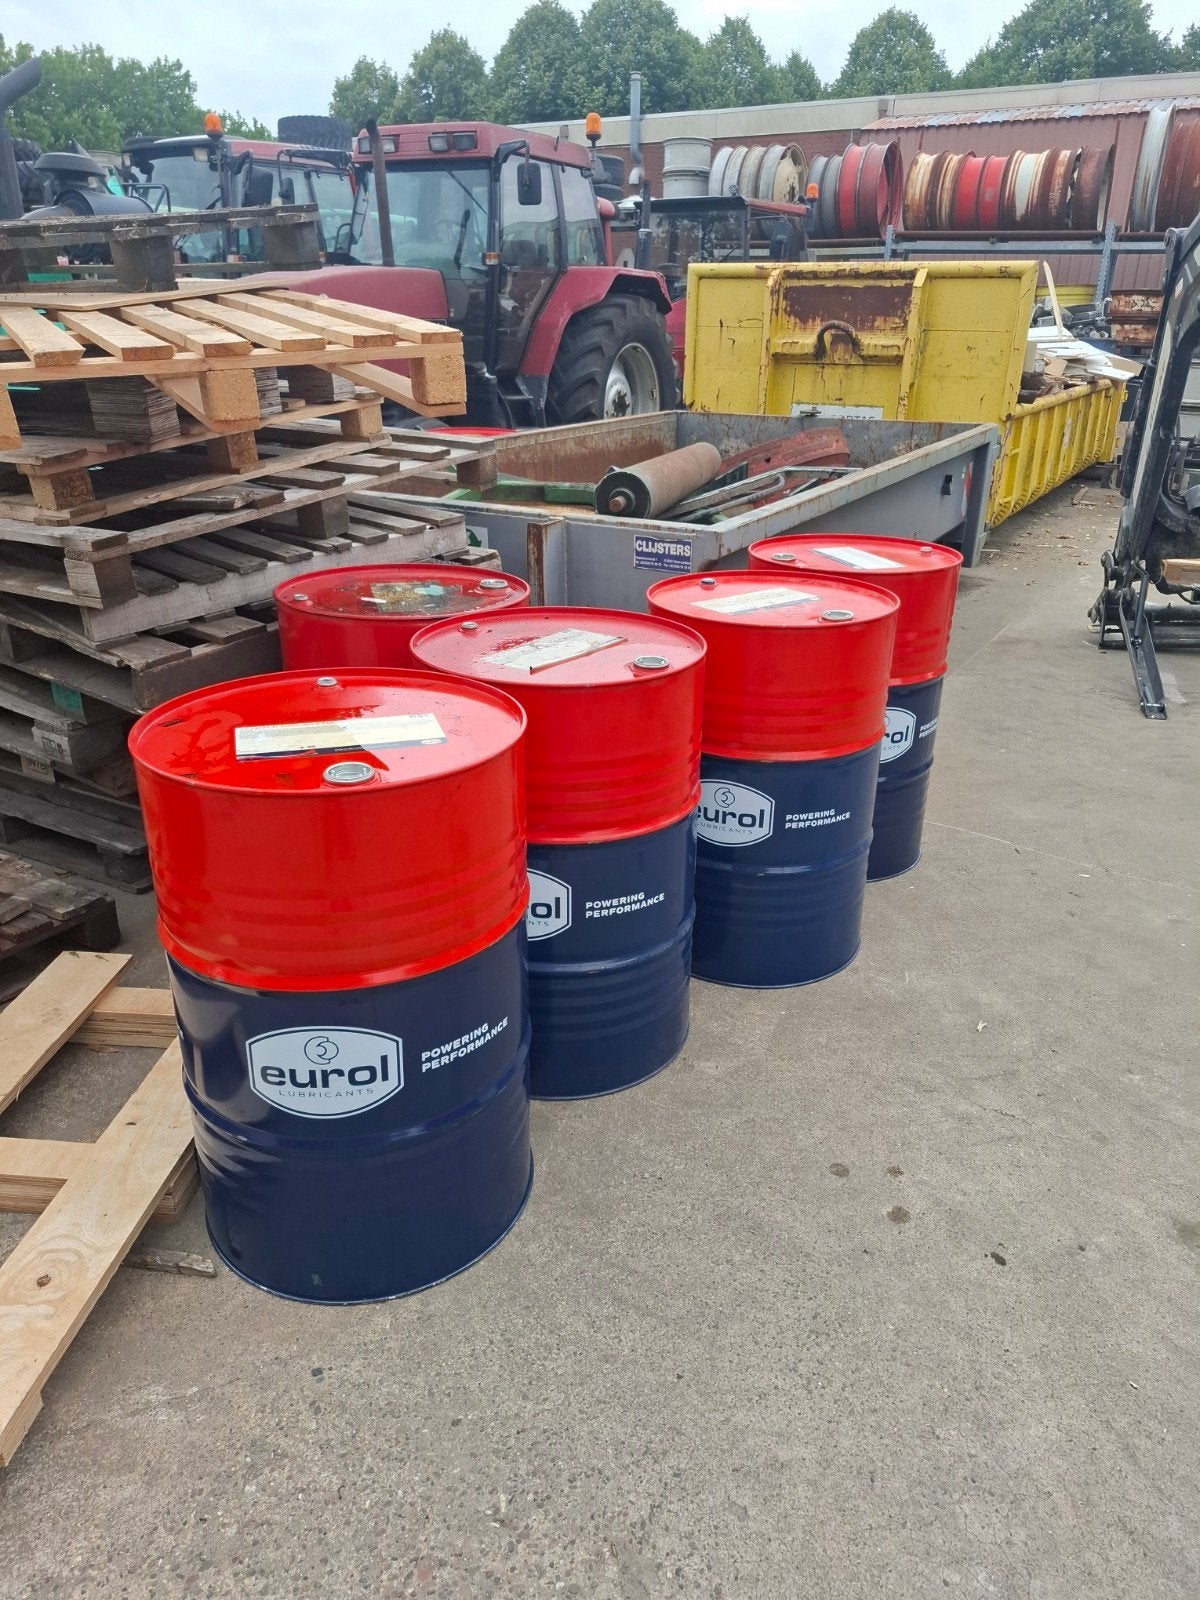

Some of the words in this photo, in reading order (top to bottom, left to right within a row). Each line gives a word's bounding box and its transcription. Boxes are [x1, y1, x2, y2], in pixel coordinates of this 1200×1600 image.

[635, 540, 691, 557] CLIJSTERS
[785, 808, 835, 822] POWERING
[785, 811, 851, 830] PERFORMANCE
[585, 892, 645, 910] POWERING
[585, 893, 665, 919] PERFORMANCE
[421, 1022, 489, 1062] POWERING
[421, 1016, 509, 1073] PERFORMANCE
[260, 1054, 389, 1089] eurol
[278, 1087, 374, 1098] LUBRICANTS
